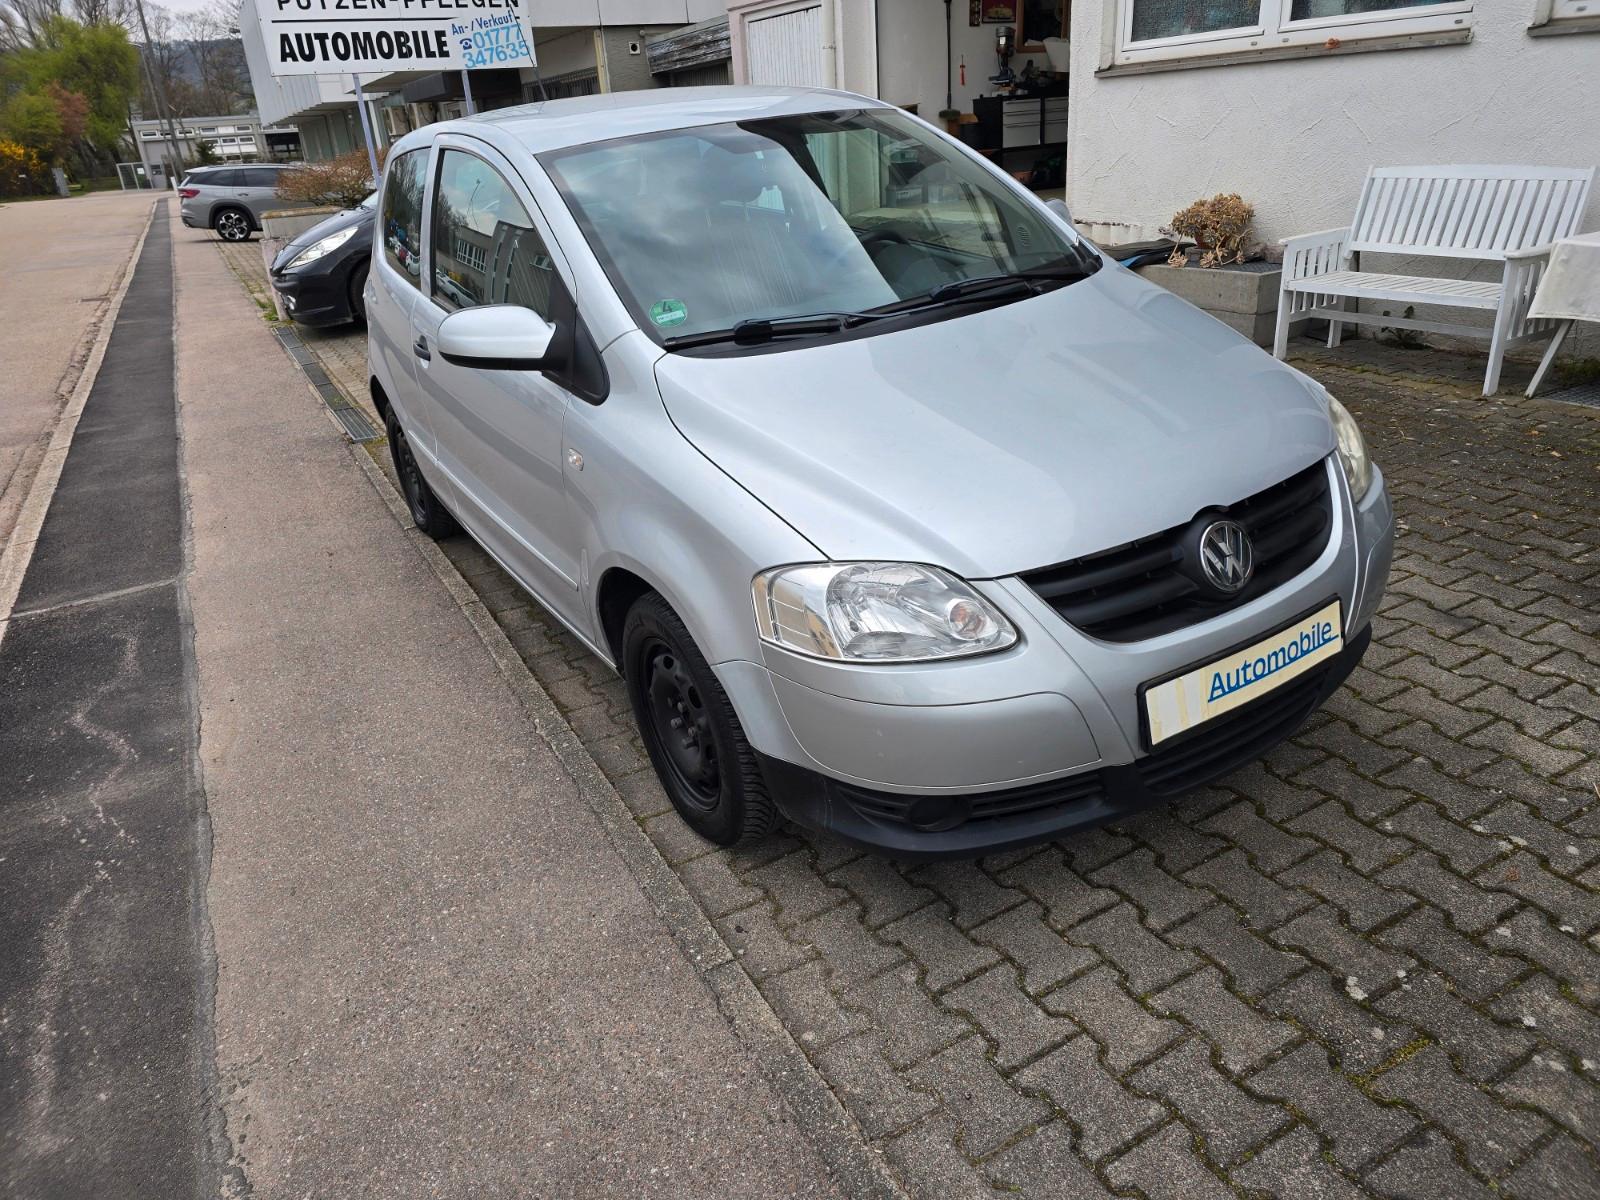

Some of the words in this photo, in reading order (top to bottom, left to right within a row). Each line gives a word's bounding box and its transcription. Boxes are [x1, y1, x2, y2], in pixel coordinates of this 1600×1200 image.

[280, 30, 450, 62] AUTOMOBILE
[472, 23, 521, 49] 01777
[462, 40, 530, 68] 347635
[1209, 621, 1335, 702] Automobile
